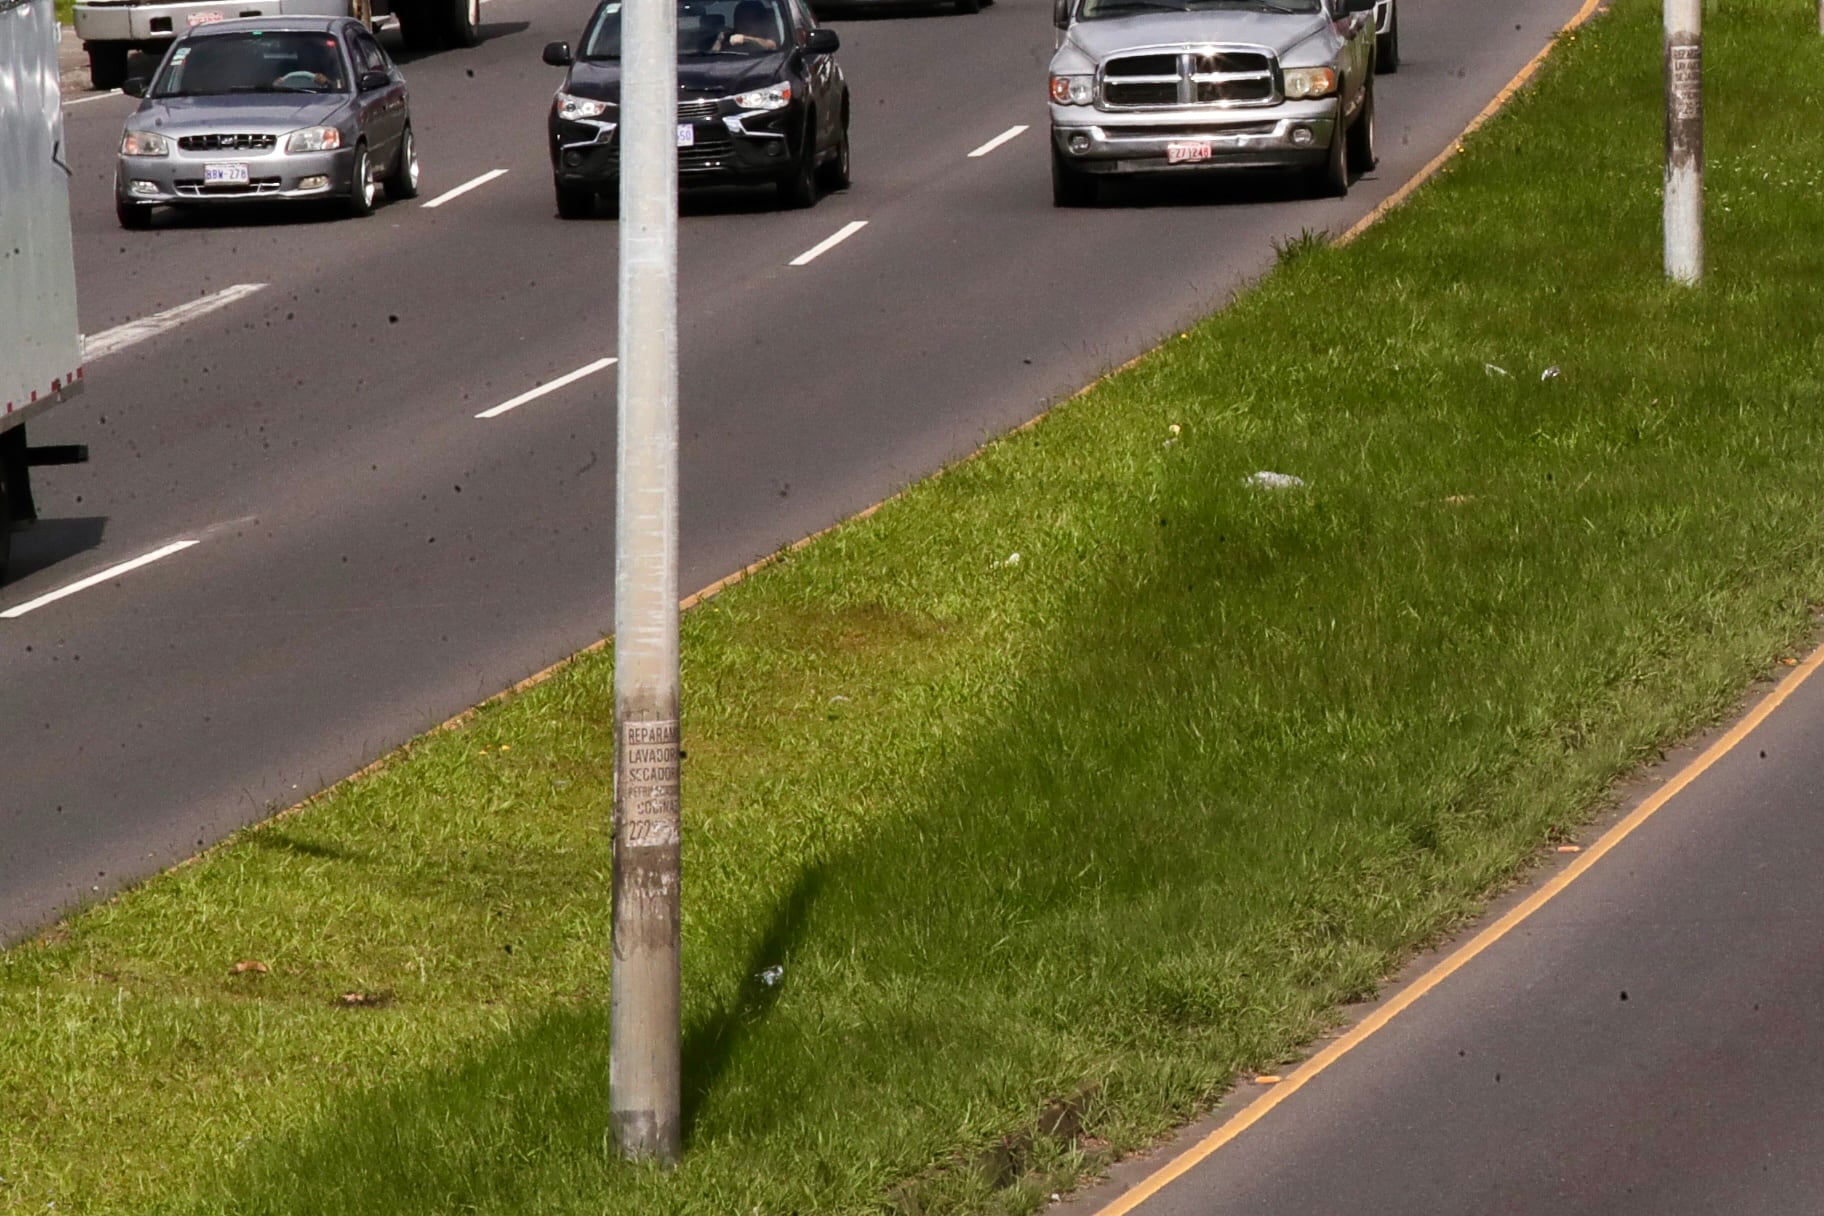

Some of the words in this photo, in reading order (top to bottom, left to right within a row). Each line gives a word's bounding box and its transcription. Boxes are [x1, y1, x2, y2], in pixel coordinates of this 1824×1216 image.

[628, 727, 678, 743] REPARAM
[629, 748, 678, 764] LAVADOR
[629, 767, 678, 782] SECADOR
